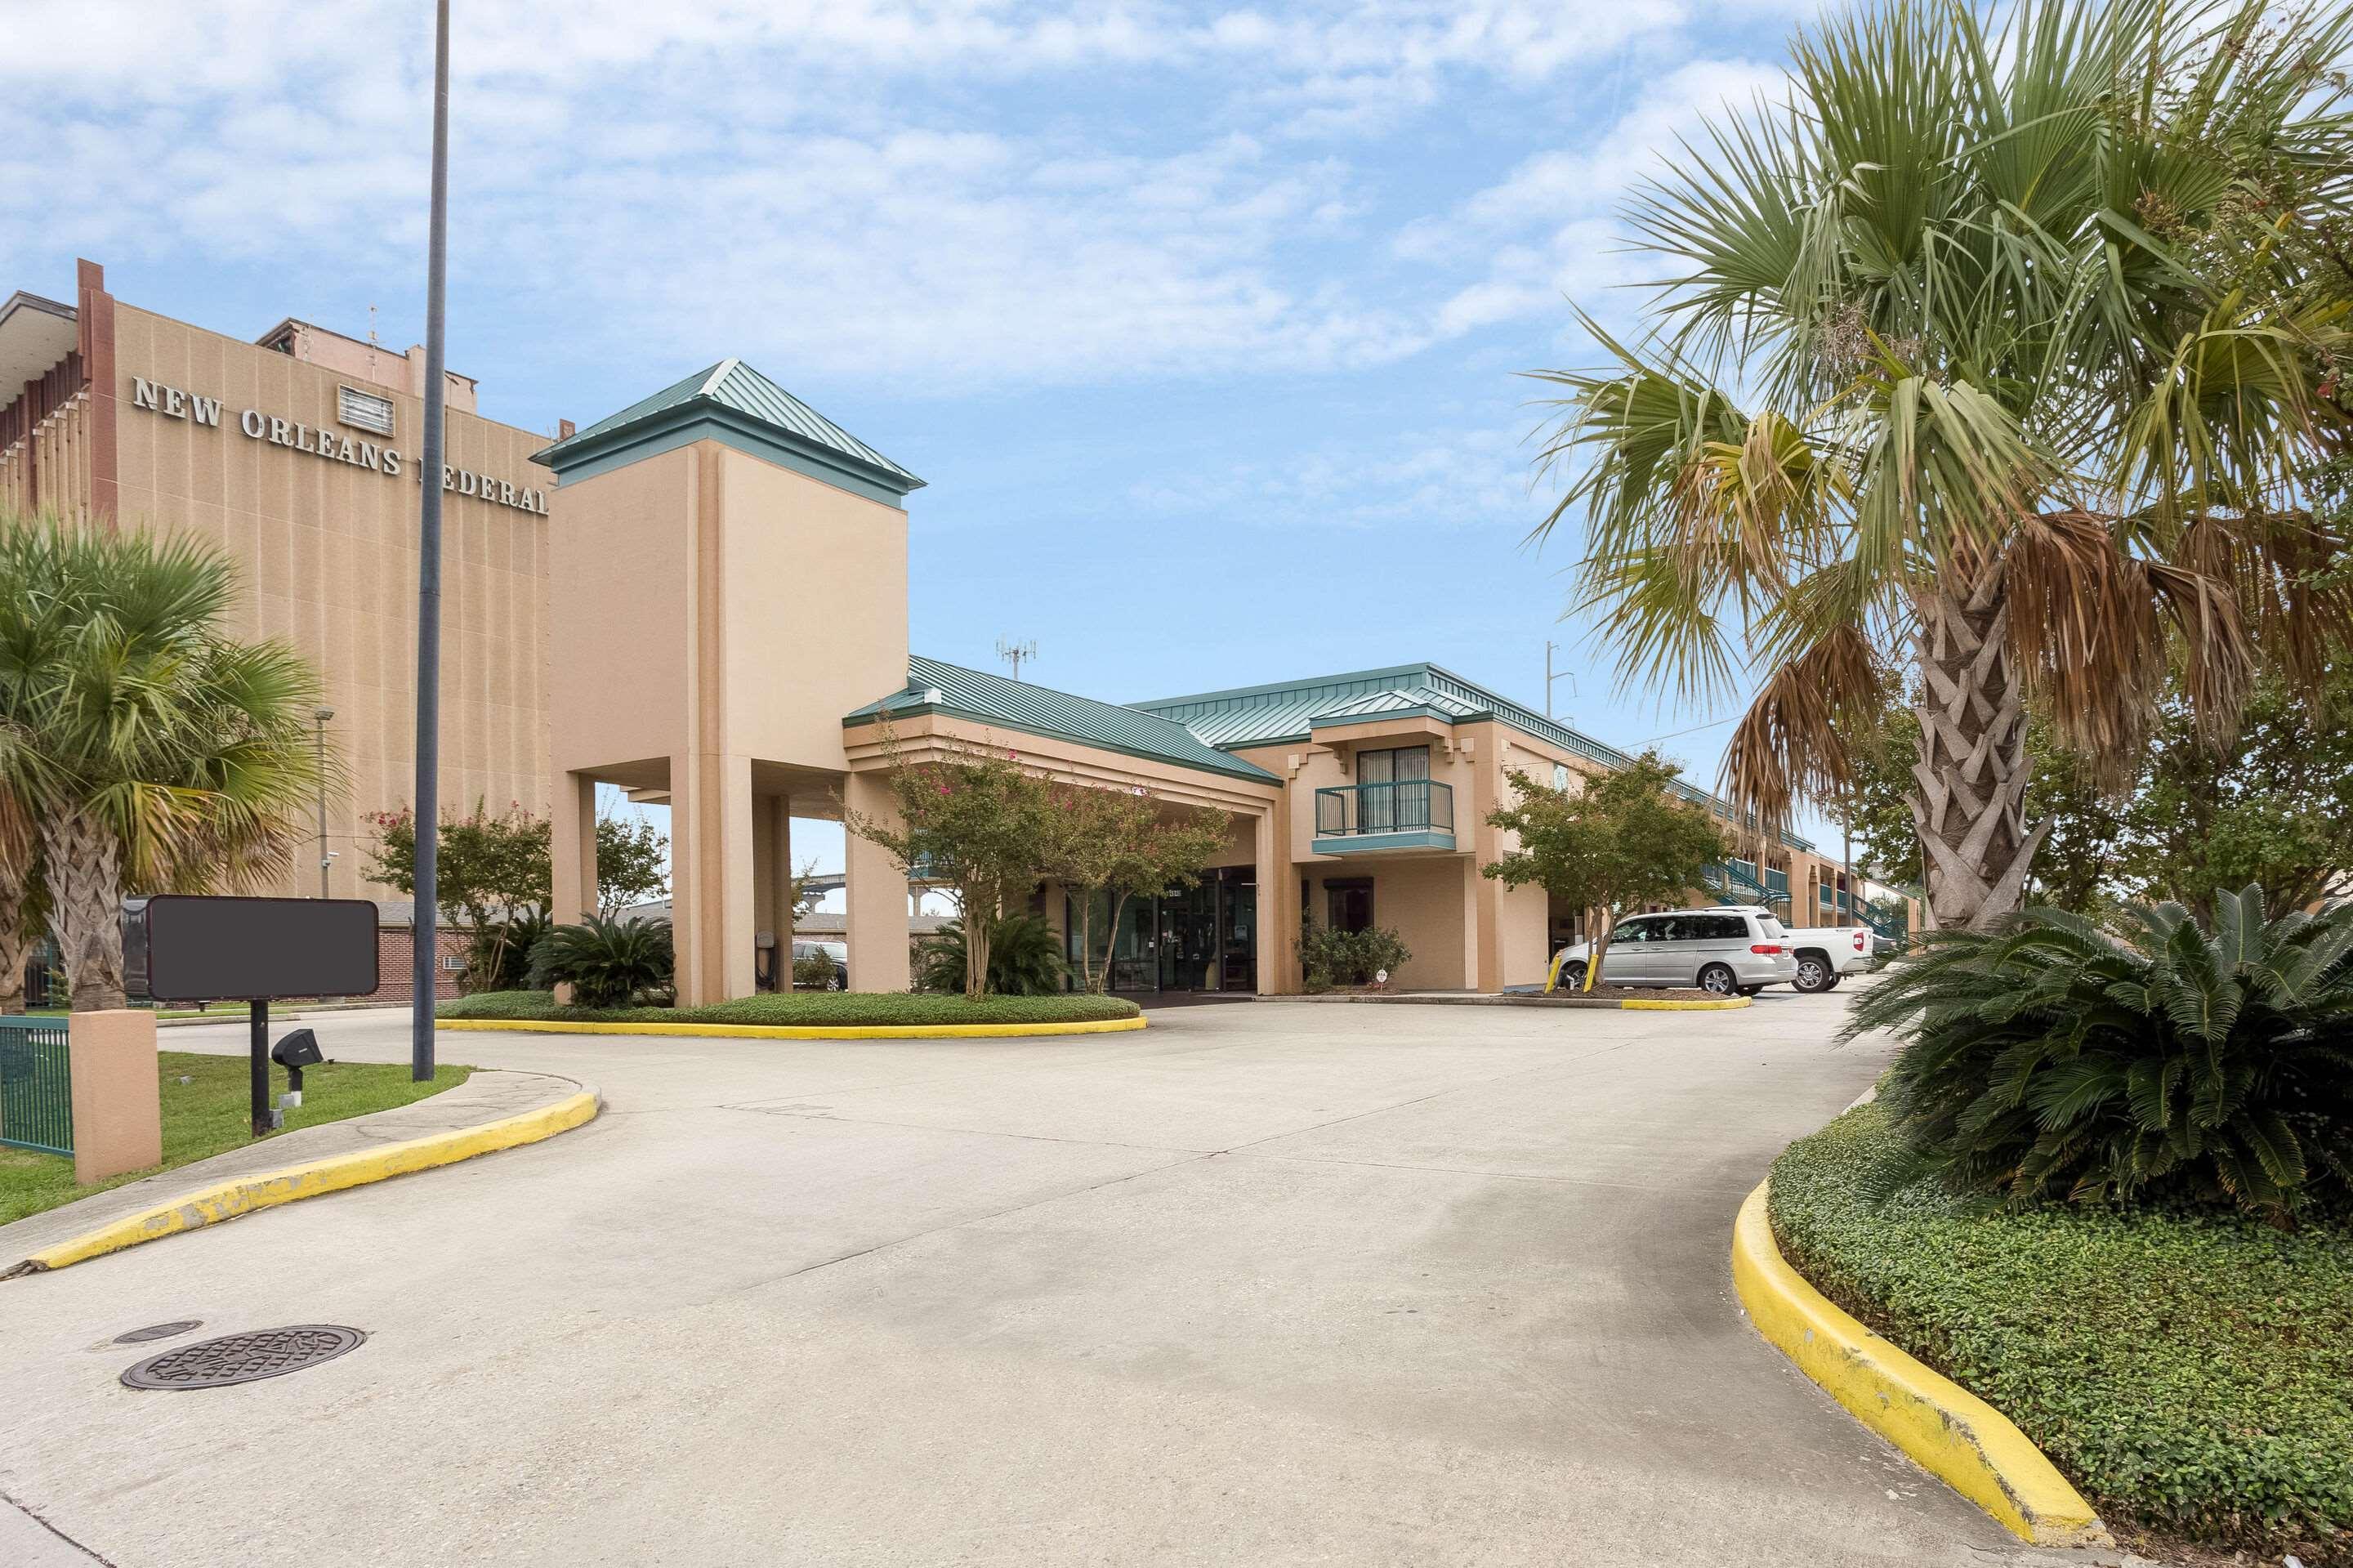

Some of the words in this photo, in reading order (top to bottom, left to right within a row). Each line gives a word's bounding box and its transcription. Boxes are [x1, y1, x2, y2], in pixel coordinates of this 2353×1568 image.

[132, 376, 224, 427] NEW
[242, 409, 400, 476] ORLEANS
[417, 457, 549, 516] EDERAL
